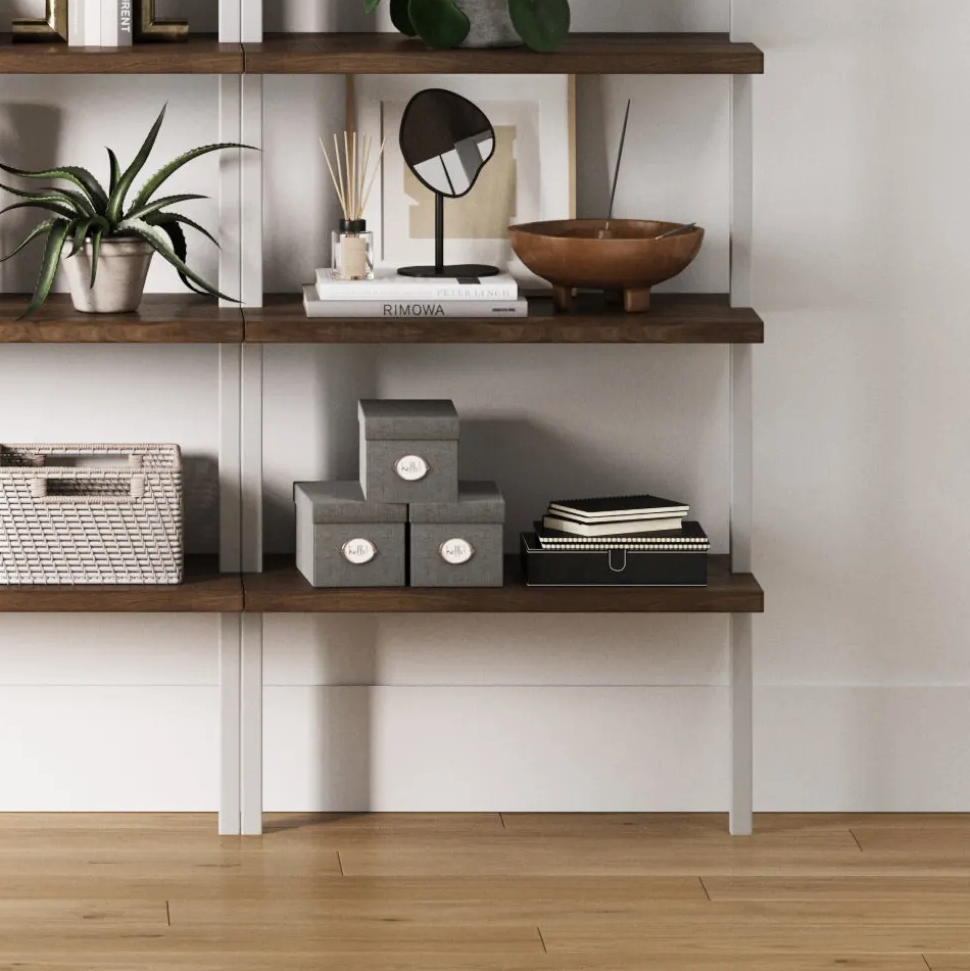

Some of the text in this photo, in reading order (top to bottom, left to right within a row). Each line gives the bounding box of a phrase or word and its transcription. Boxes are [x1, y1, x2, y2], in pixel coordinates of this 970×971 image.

[436, 288, 471, 298] PETER
[474, 288, 511, 298] LYNCH
[383, 303, 445, 317] RIMOWA
